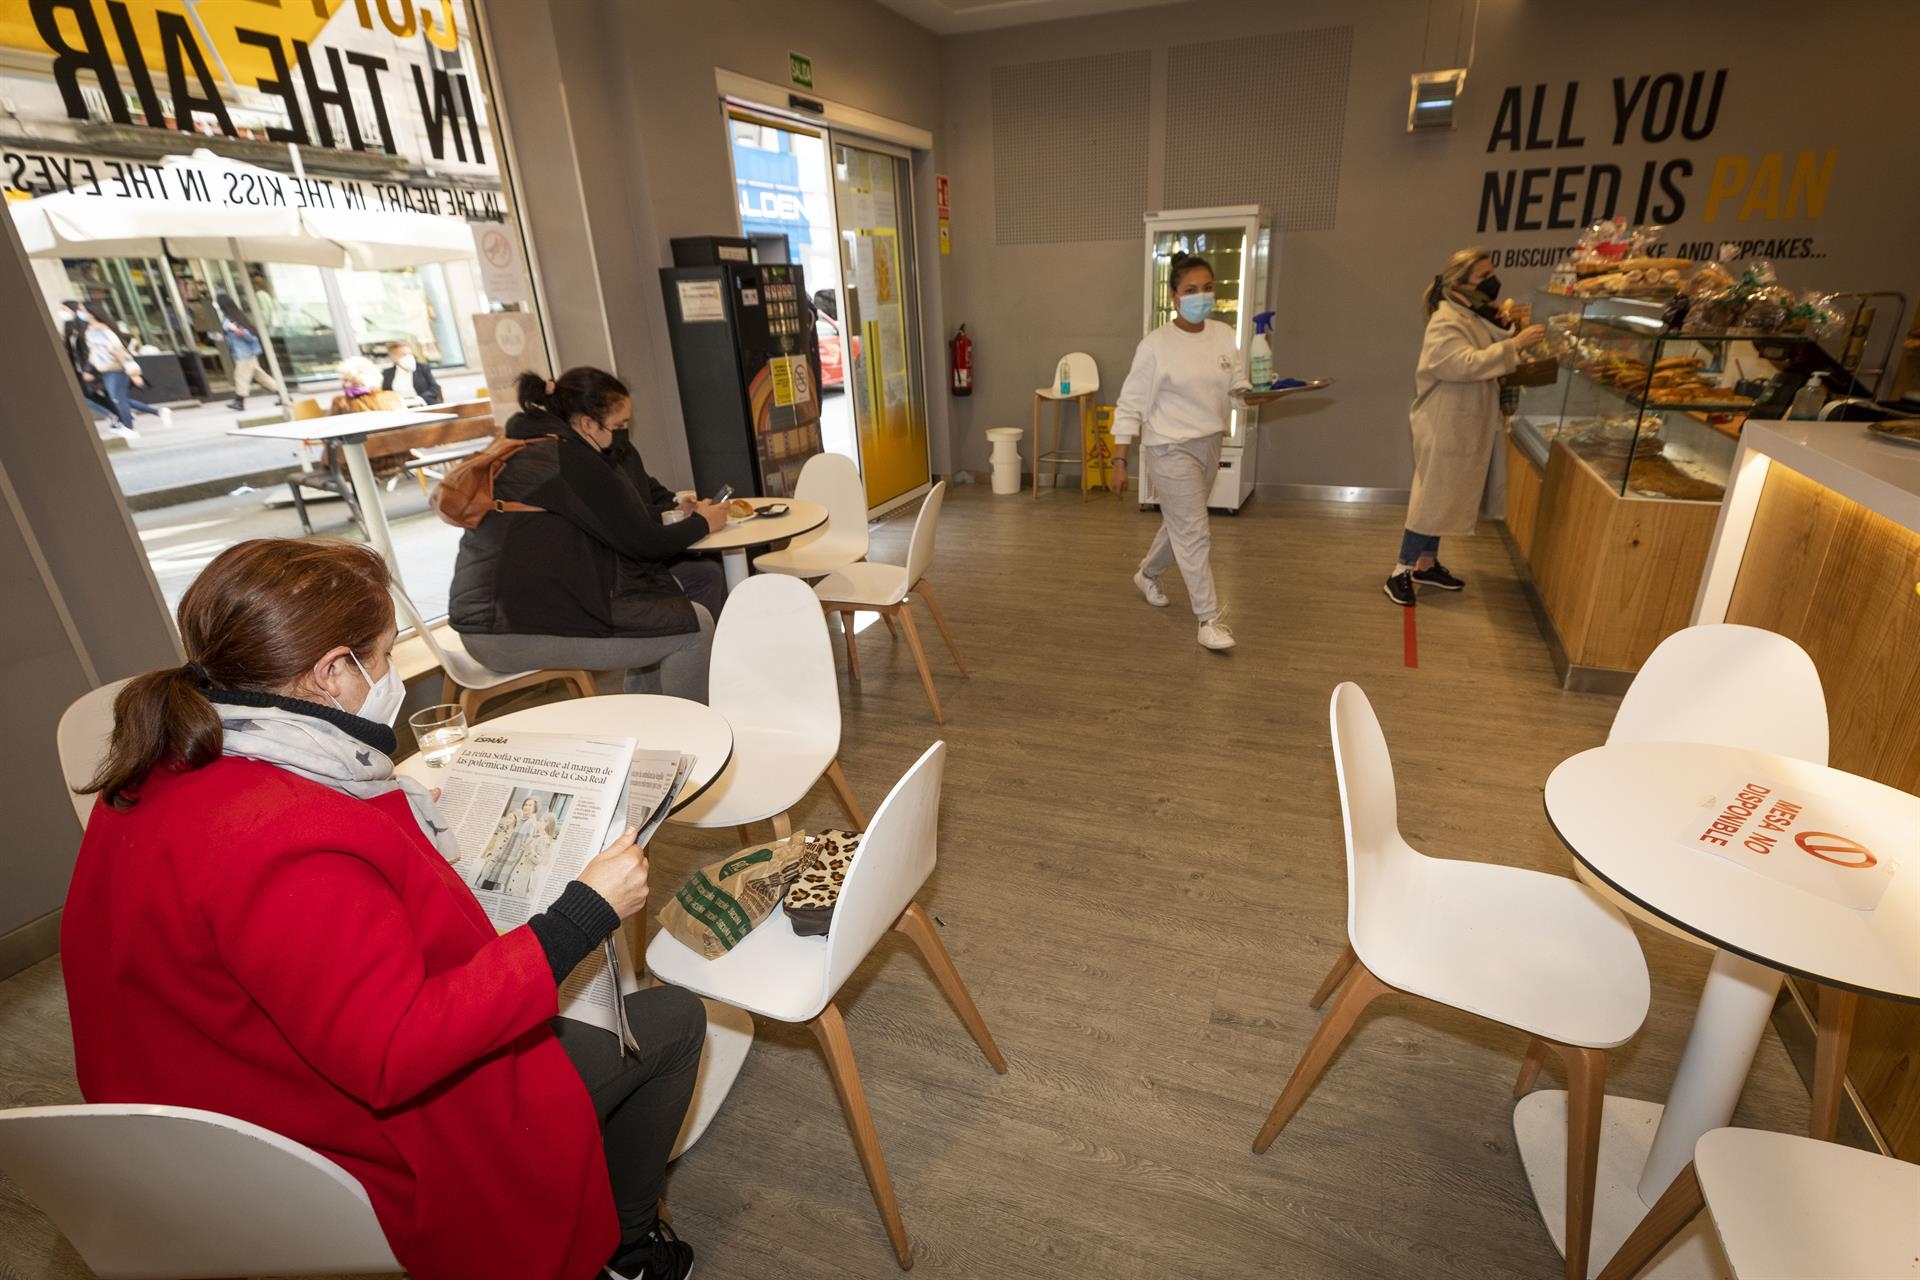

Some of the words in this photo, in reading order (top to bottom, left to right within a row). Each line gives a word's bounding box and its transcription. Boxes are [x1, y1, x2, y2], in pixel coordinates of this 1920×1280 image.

[1486, 80, 1586, 153] ALL
[1612, 68, 1729, 146] YOU
[1476, 164, 1622, 233] NEED
[1633, 158, 1694, 226] IS
[1703, 148, 1838, 225] PAN
[1676, 239, 1714, 261] AND
[456, 756, 467, 764] las
[467, 759, 508, 770] polémicas
[509, 763, 548, 777] familiares
[549, 769, 560, 778] de
[560, 770, 569, 779] la
[569, 772, 588, 782] Casa
[588, 774, 607, 785] Real
[522, 757, 561, 768] mantiene
[561, 761, 571, 770] al
[570, 763, 601, 775] margen
[602, 767, 613, 776] de
[1699, 783, 1772, 847] DISPONIBLE
[1757, 799, 1803, 833] MESA
[1743, 831, 1778, 855] NO
